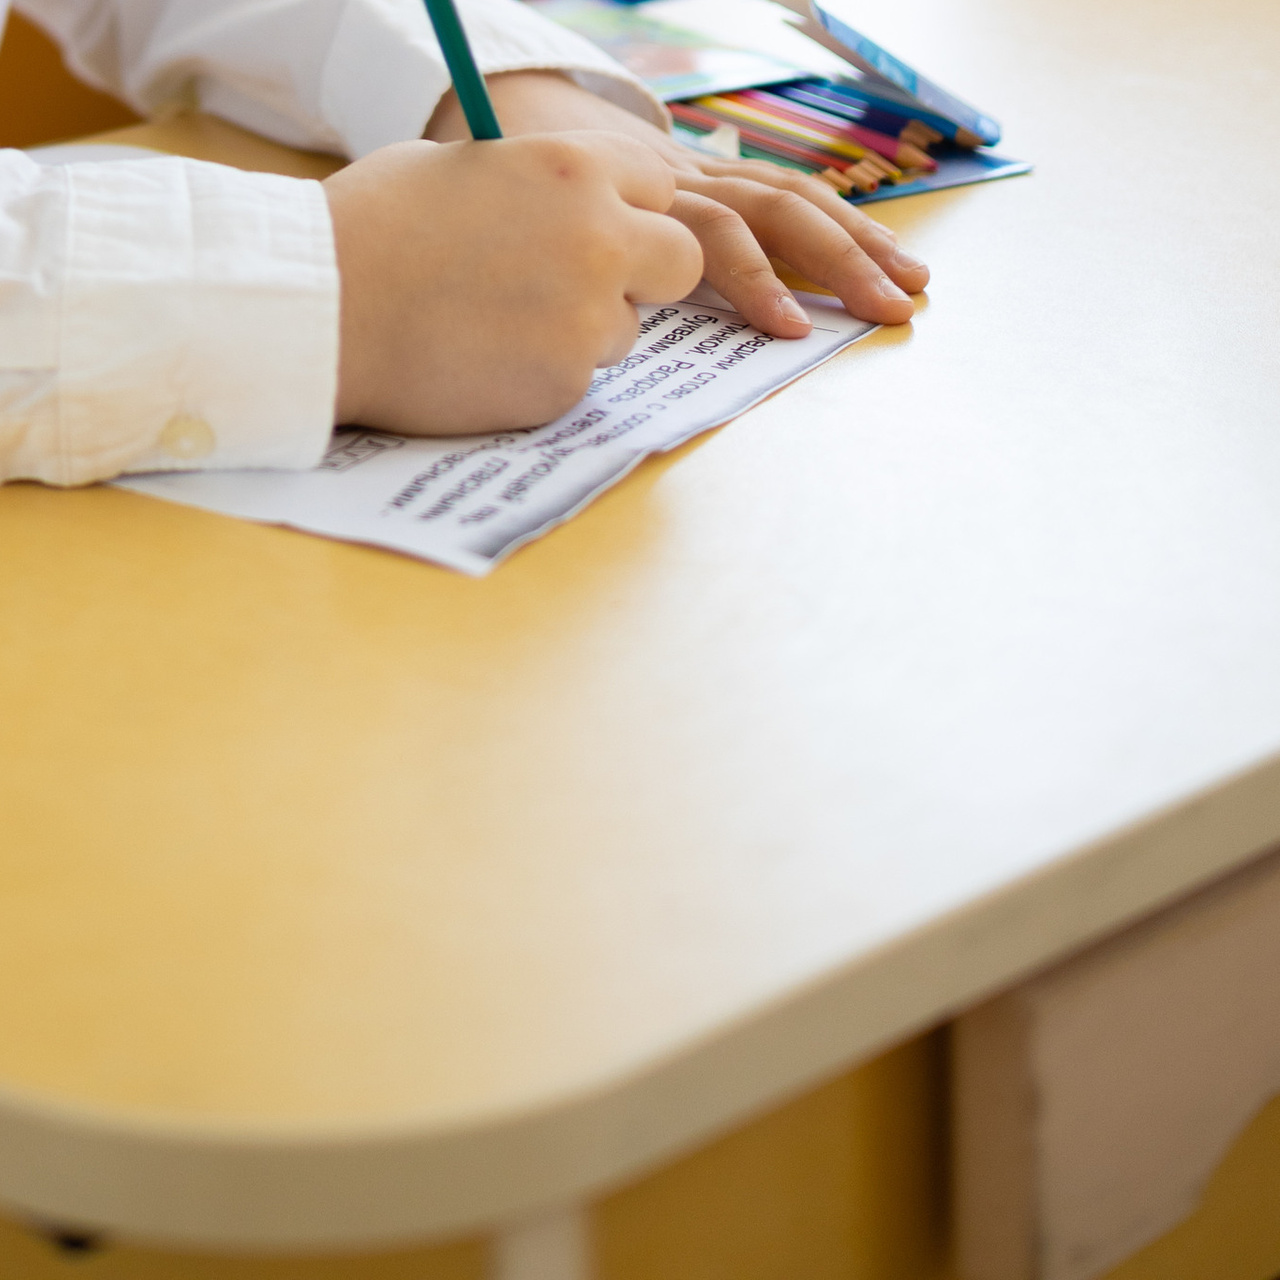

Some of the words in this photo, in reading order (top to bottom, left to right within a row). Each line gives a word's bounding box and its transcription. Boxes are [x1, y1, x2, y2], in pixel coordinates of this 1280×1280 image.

[642, 314, 719, 354] буквами
[684, 322, 750, 356] тинкой.
[711, 333, 774, 371] оедини
[607, 359, 695, 403] Раскрась
[662, 372, 717, 400] слово
